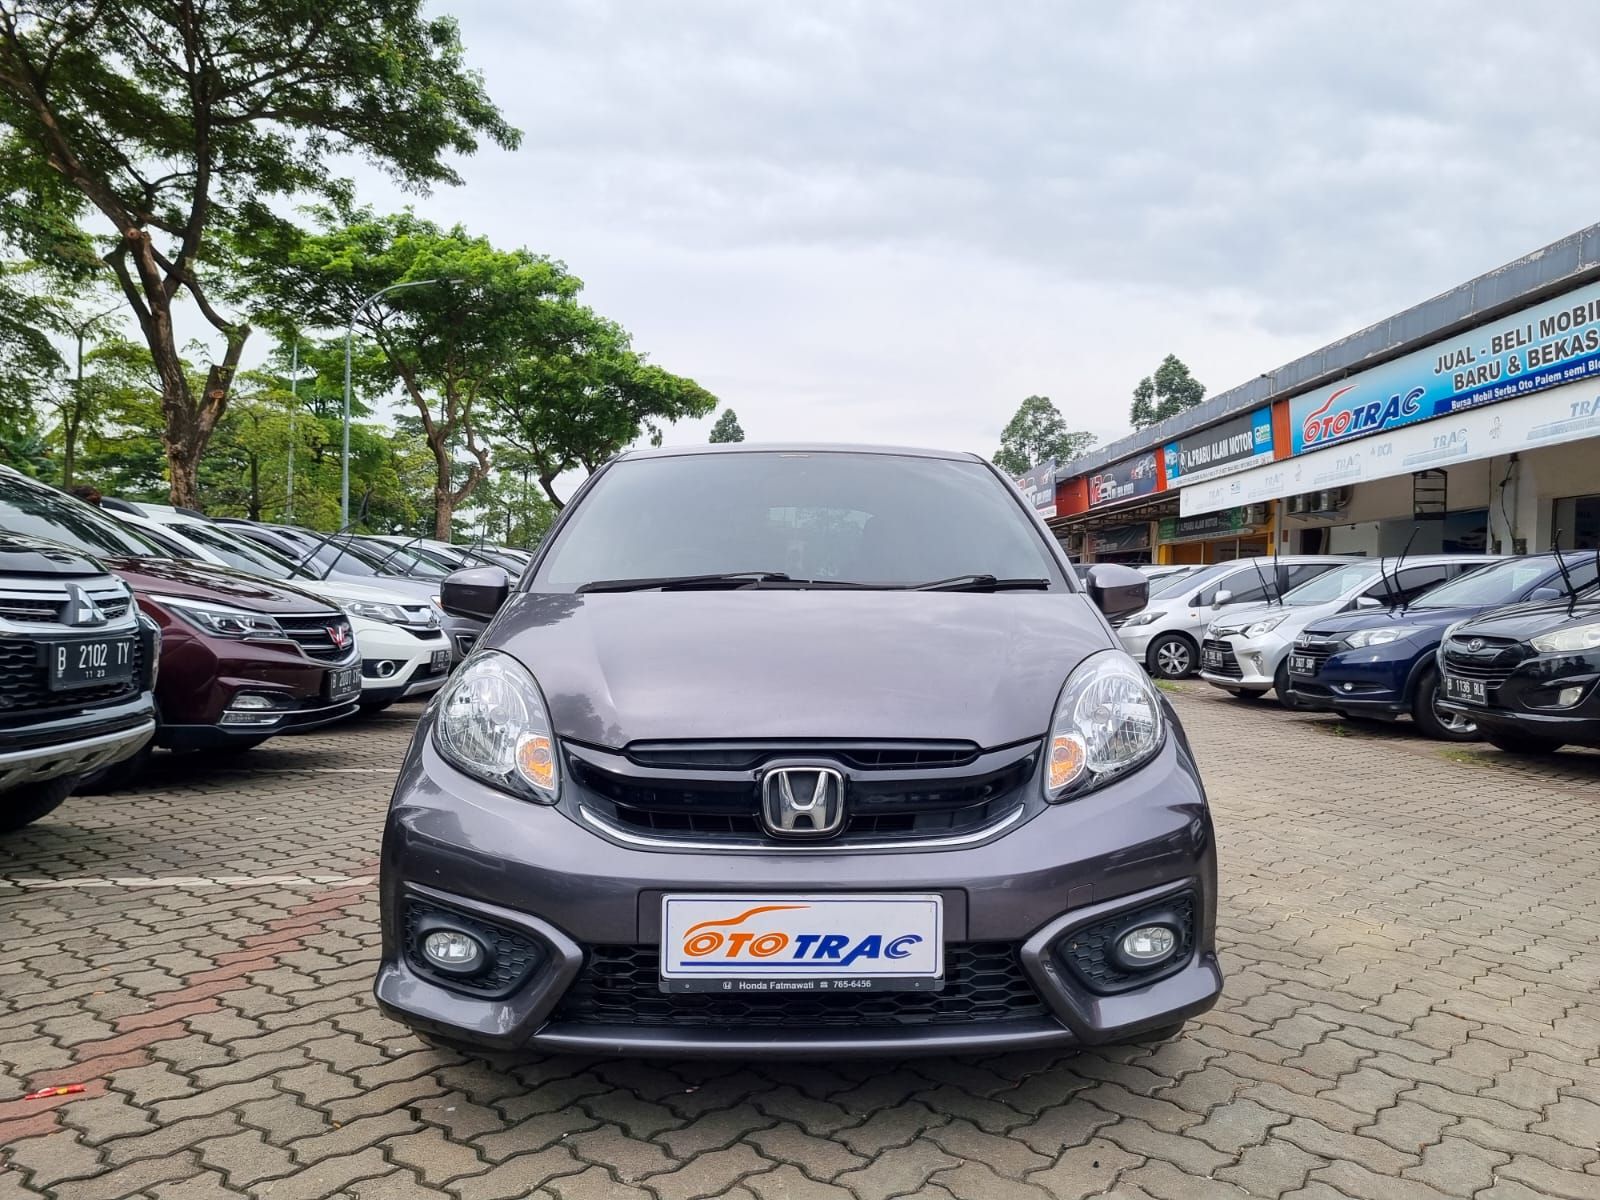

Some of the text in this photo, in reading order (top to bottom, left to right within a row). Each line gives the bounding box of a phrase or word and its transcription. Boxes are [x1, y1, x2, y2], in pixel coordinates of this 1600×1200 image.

[1434, 346, 1476, 374] JUAL
[1491, 324, 1532, 352] BELI
[1539, 300, 1600, 338] MOBI
[1453, 329, 1599, 391] BARU & BEKAS
[1451, 398, 1472, 410] Bursa
[1473, 390, 1493, 404] Mobil
[1494, 384, 1517, 397] Serba
[1518, 380, 1533, 391] Oto
[1535, 372, 1562, 387] Palem
[1564, 363, 1586, 379] semi
[1303, 387, 1425, 445] OTOTRAC
[1211, 437, 1229, 461] ALAM
[1229, 431, 1254, 456] MOTOR
[57, 642, 130, 670] B 2102 TY
[1456, 679, 1470, 693] 1136
[683, 932, 923, 962] OTOTRAC
[739, 979, 872, 990] Honda Fatmawati 765-6456
